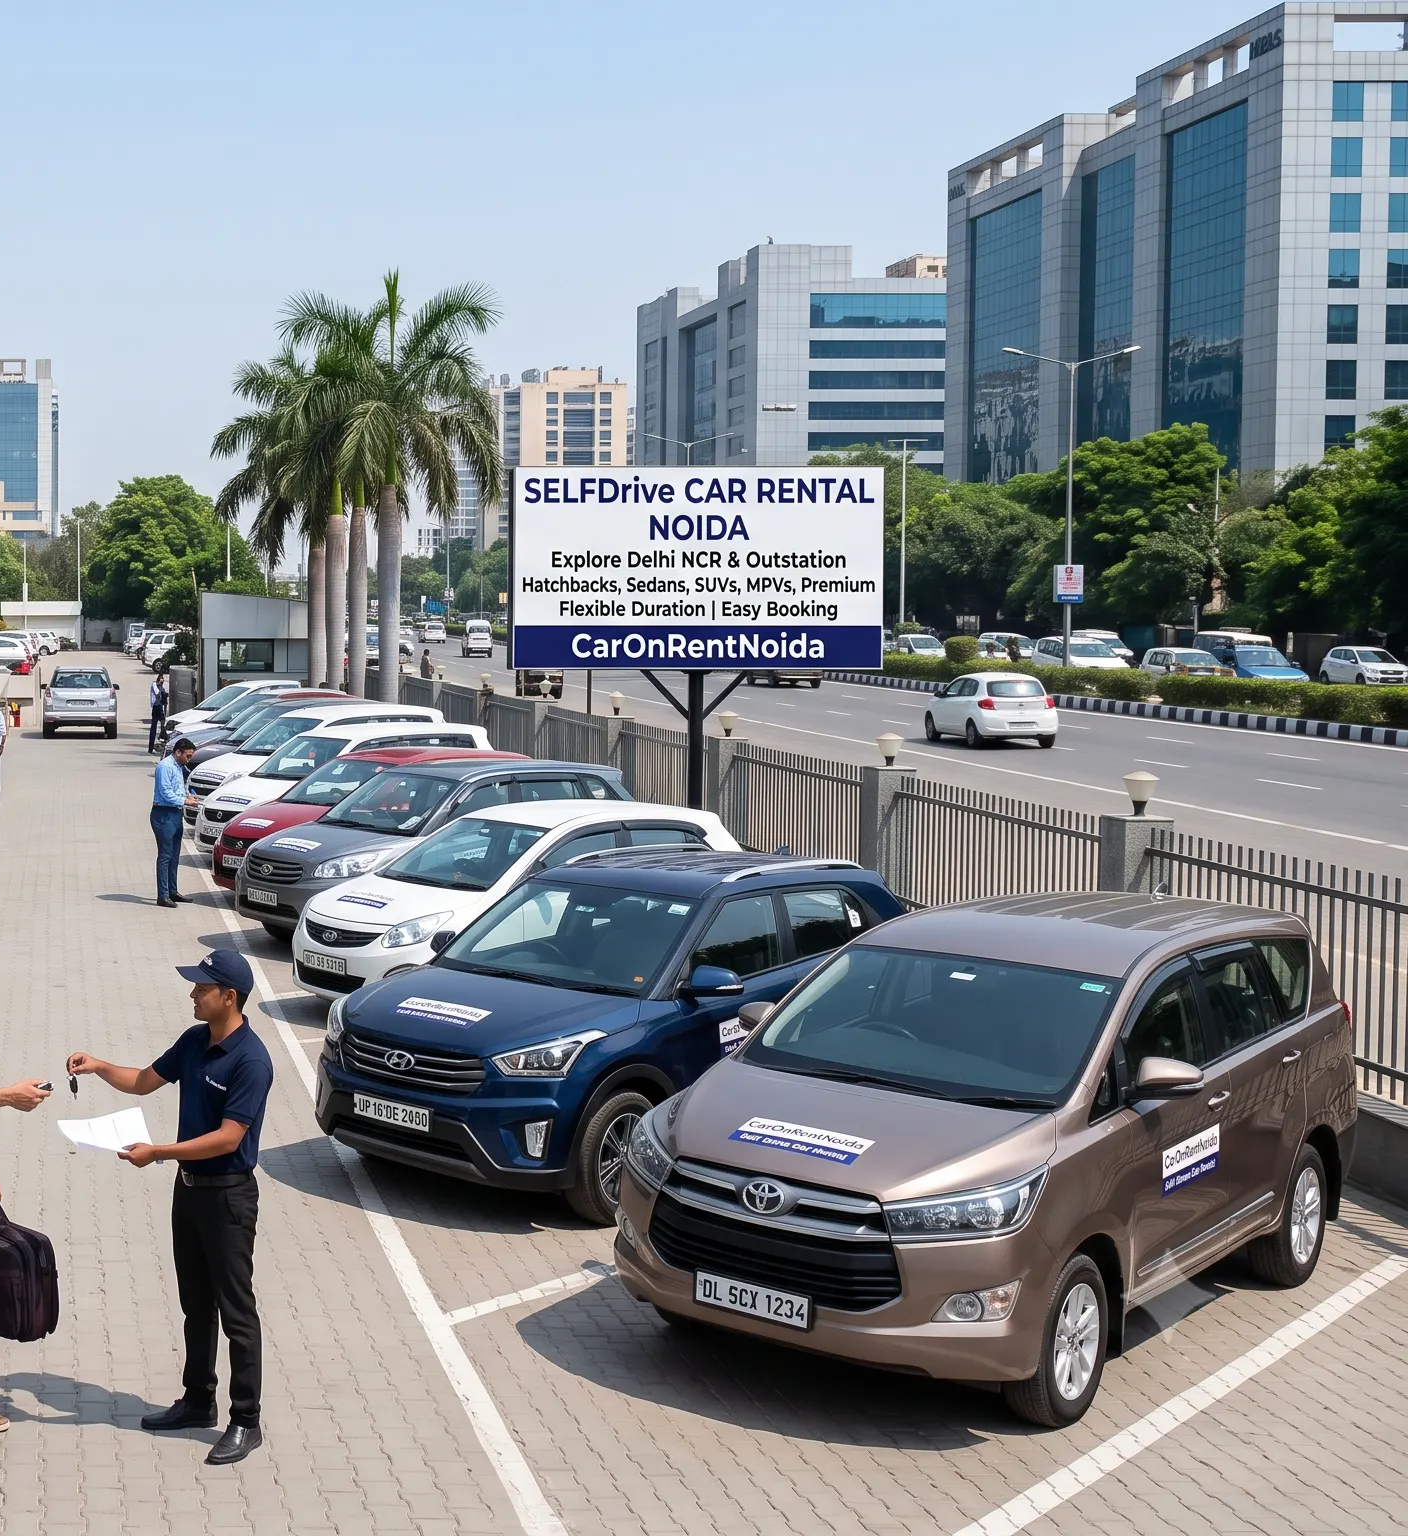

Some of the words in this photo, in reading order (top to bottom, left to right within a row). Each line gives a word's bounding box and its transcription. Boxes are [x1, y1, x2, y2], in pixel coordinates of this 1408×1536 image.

[524, 476, 675, 504] SELFDrive
[684, 477, 748, 504] CAR
[757, 478, 875, 504] RENTAL
[649, 514, 750, 541] NOIDA
[551, 551, 622, 572] Explore
[627, 550, 676, 569] Delhi
[681, 551, 722, 568] NCR
[727, 552, 740, 568] &
[746, 550, 847, 569] Outstation
[521, 576, 622, 595] Hatchbacks,
[626, 576, 690, 595] Sedans,
[694, 577, 742, 595] SUVs,
[746, 577, 797, 595] MPVs,
[801, 577, 876, 593] Premium
[559, 600, 626, 617] Flexible
[631, 600, 706, 617] Duration
[721, 602, 761, 621] Easy
[767, 600, 839, 621] Booking
[571, 632, 826, 659] CarOnRentNoida
[359, 1097, 371, 1113] UP
[373, 1102, 383, 1117] 16
[702, 1278, 723, 1301] DL
[728, 1285, 759, 1310] 5CX
[765, 1294, 805, 1321] 1234
